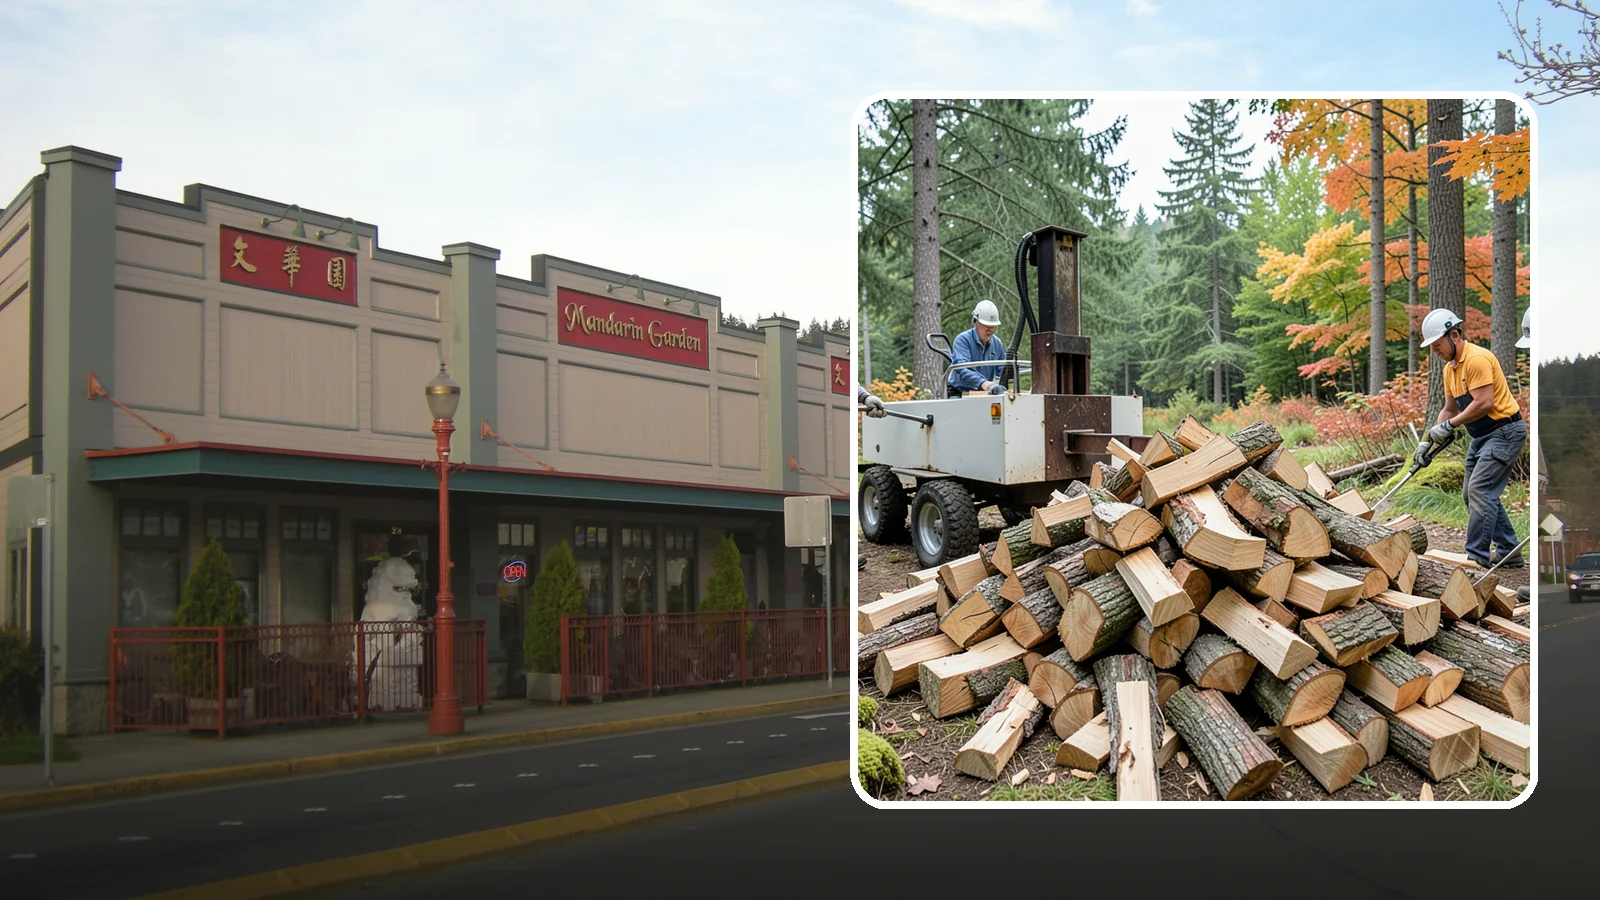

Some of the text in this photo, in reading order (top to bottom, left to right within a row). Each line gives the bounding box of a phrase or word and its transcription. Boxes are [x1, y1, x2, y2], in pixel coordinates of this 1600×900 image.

[231, 236, 347, 291] 文華園
[564, 302, 701, 352] Mandarin Garden
[834, 362, 847, 386] 文
[503, 565, 527, 578] OPEN
